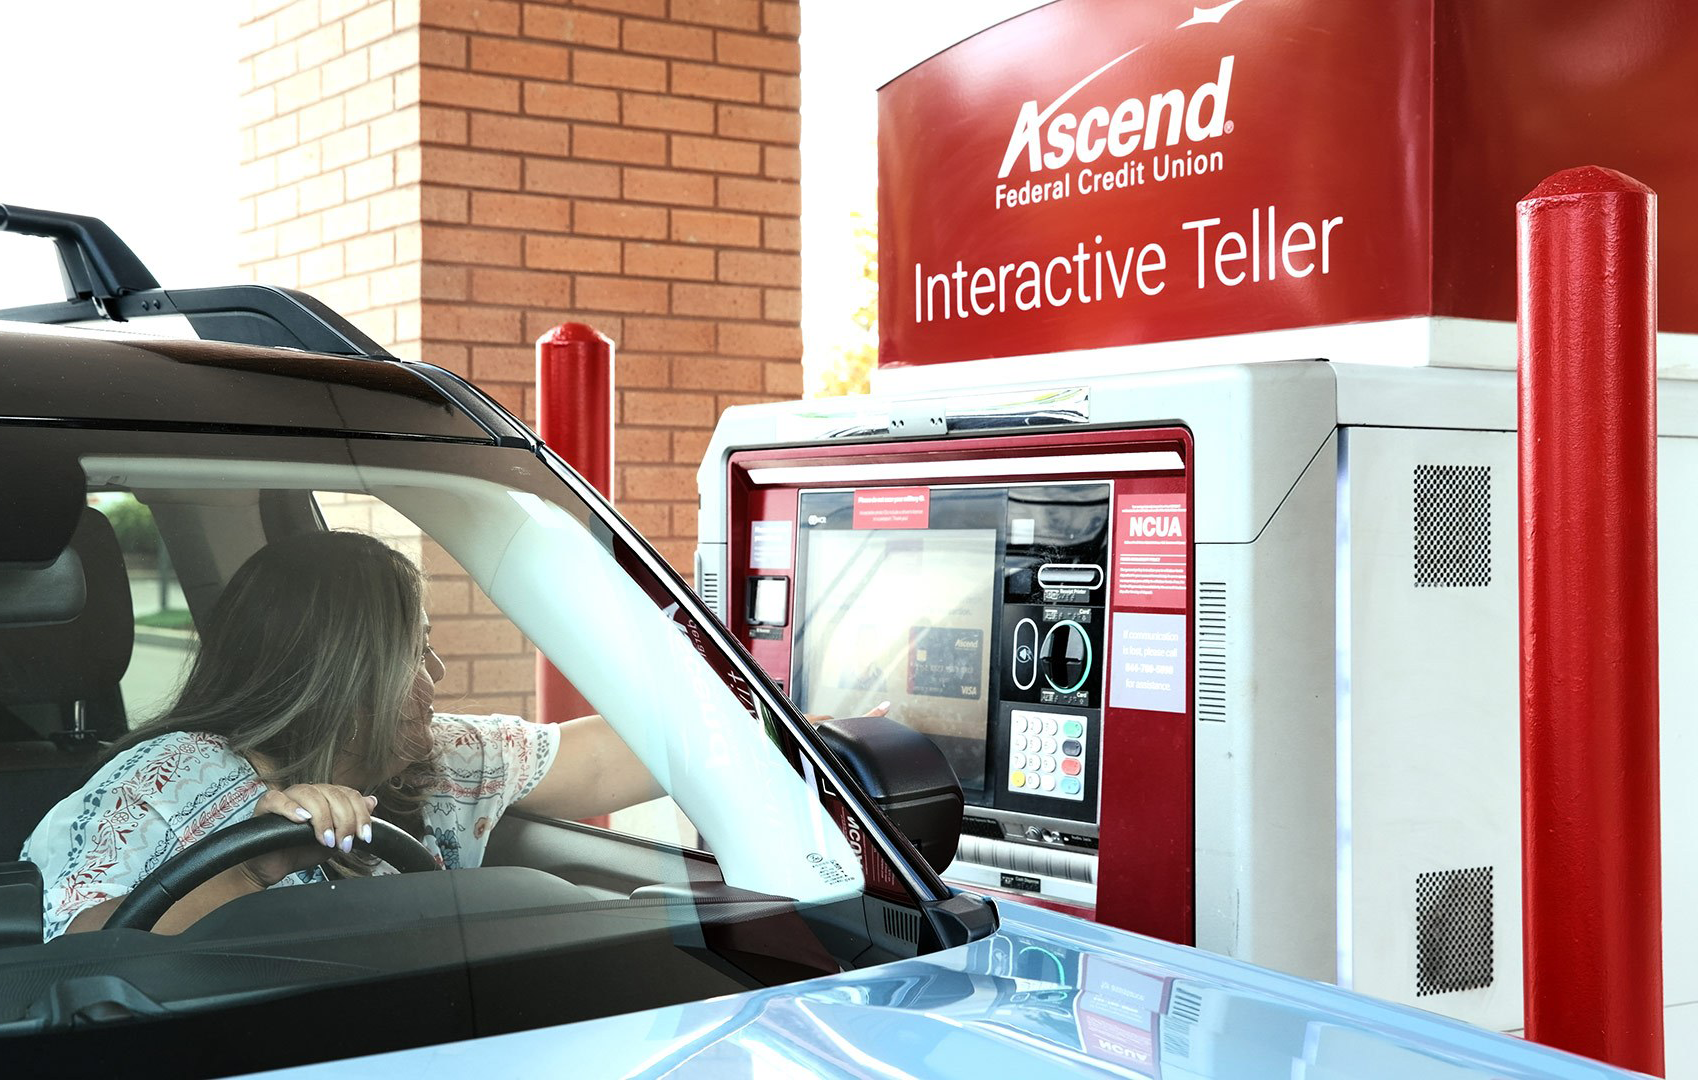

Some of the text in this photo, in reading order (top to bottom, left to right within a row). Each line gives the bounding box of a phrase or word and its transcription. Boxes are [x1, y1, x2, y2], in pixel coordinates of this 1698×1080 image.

[997, 54, 1235, 179] Ascend
[995, 151, 1223, 209] Federal Credit Union
[915, 205, 1343, 323] Interactive Teller
[1129, 516, 1182, 537] NCUA
[961, 685, 977, 696] VISA
